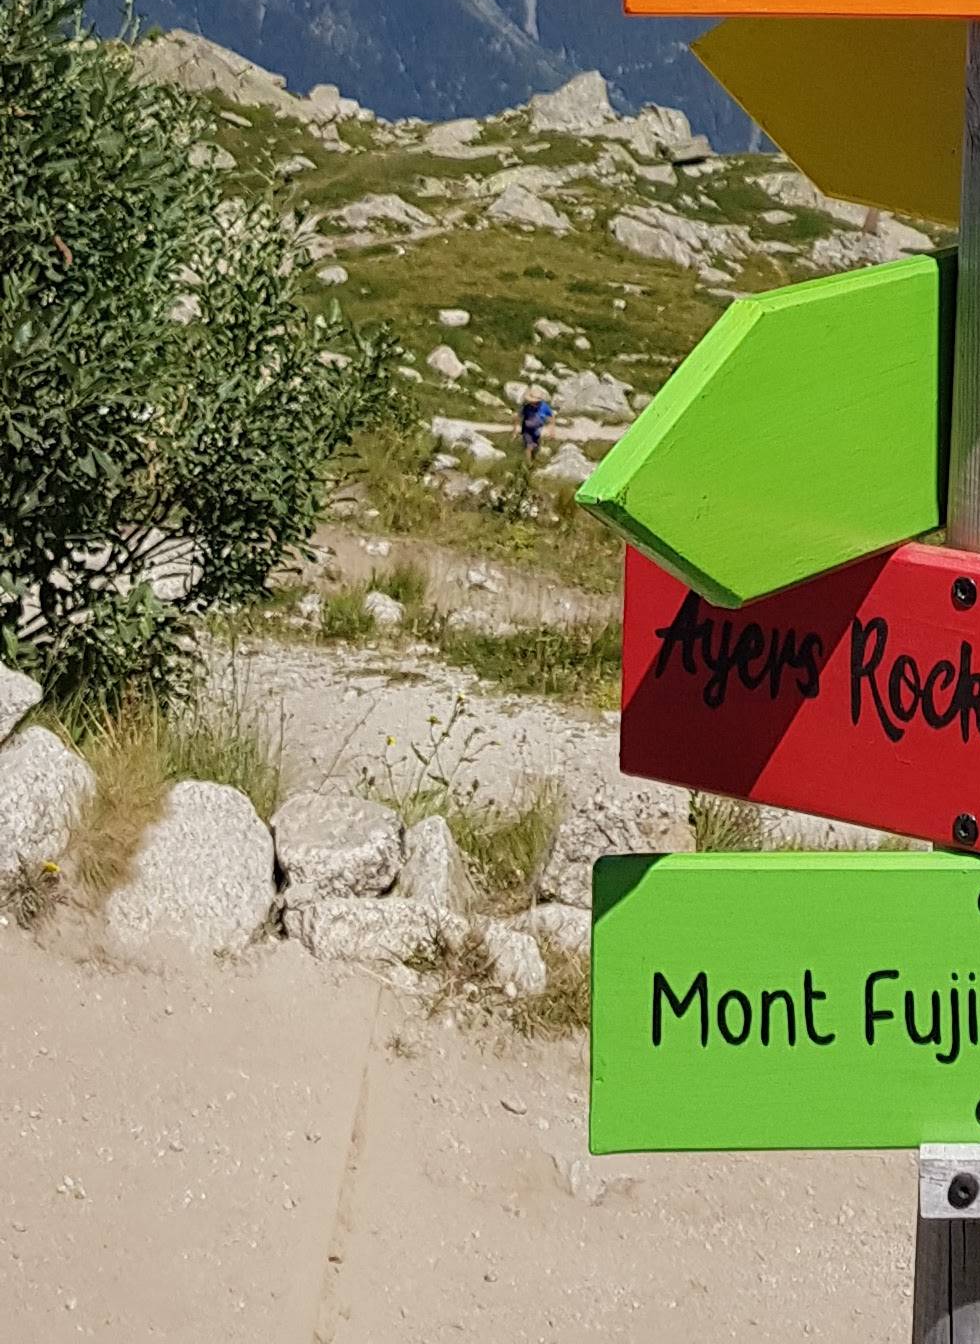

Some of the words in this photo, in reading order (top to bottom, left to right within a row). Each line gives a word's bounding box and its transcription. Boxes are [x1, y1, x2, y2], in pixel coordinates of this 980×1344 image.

[654, 588, 824, 710] Ayers
[651, 968, 836, 1048] Mont
[864, 968, 979, 1065] Fuji
